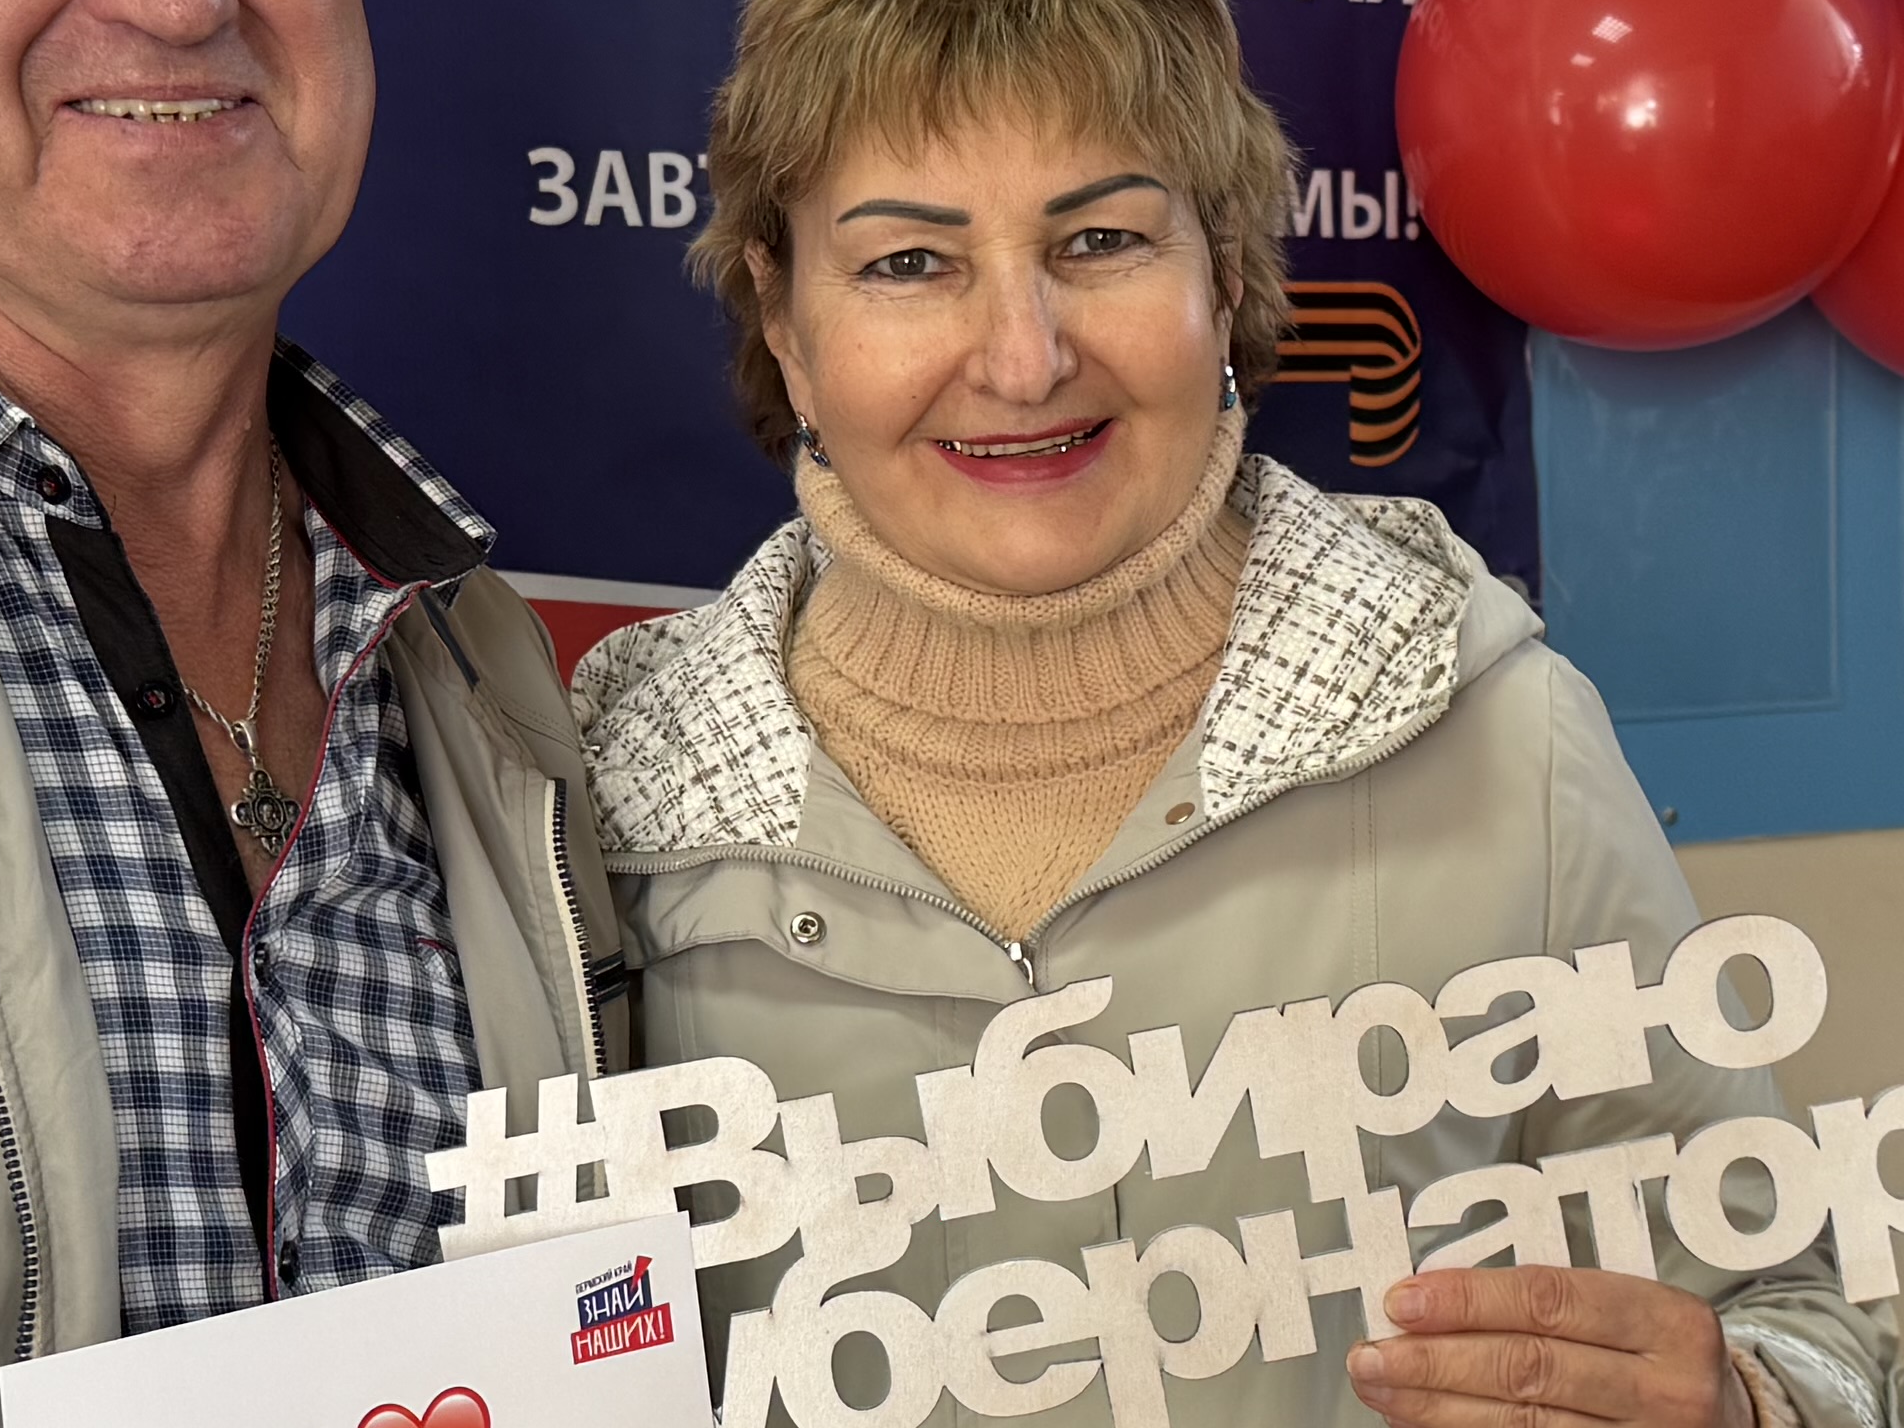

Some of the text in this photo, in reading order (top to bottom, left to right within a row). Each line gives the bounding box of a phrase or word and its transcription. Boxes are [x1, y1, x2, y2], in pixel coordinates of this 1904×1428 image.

[527, 146, 708, 229] ЗАВ
[425, 914, 1828, 1270] #Выбираю
[575, 1309, 666, 1360] НАШИХ!
